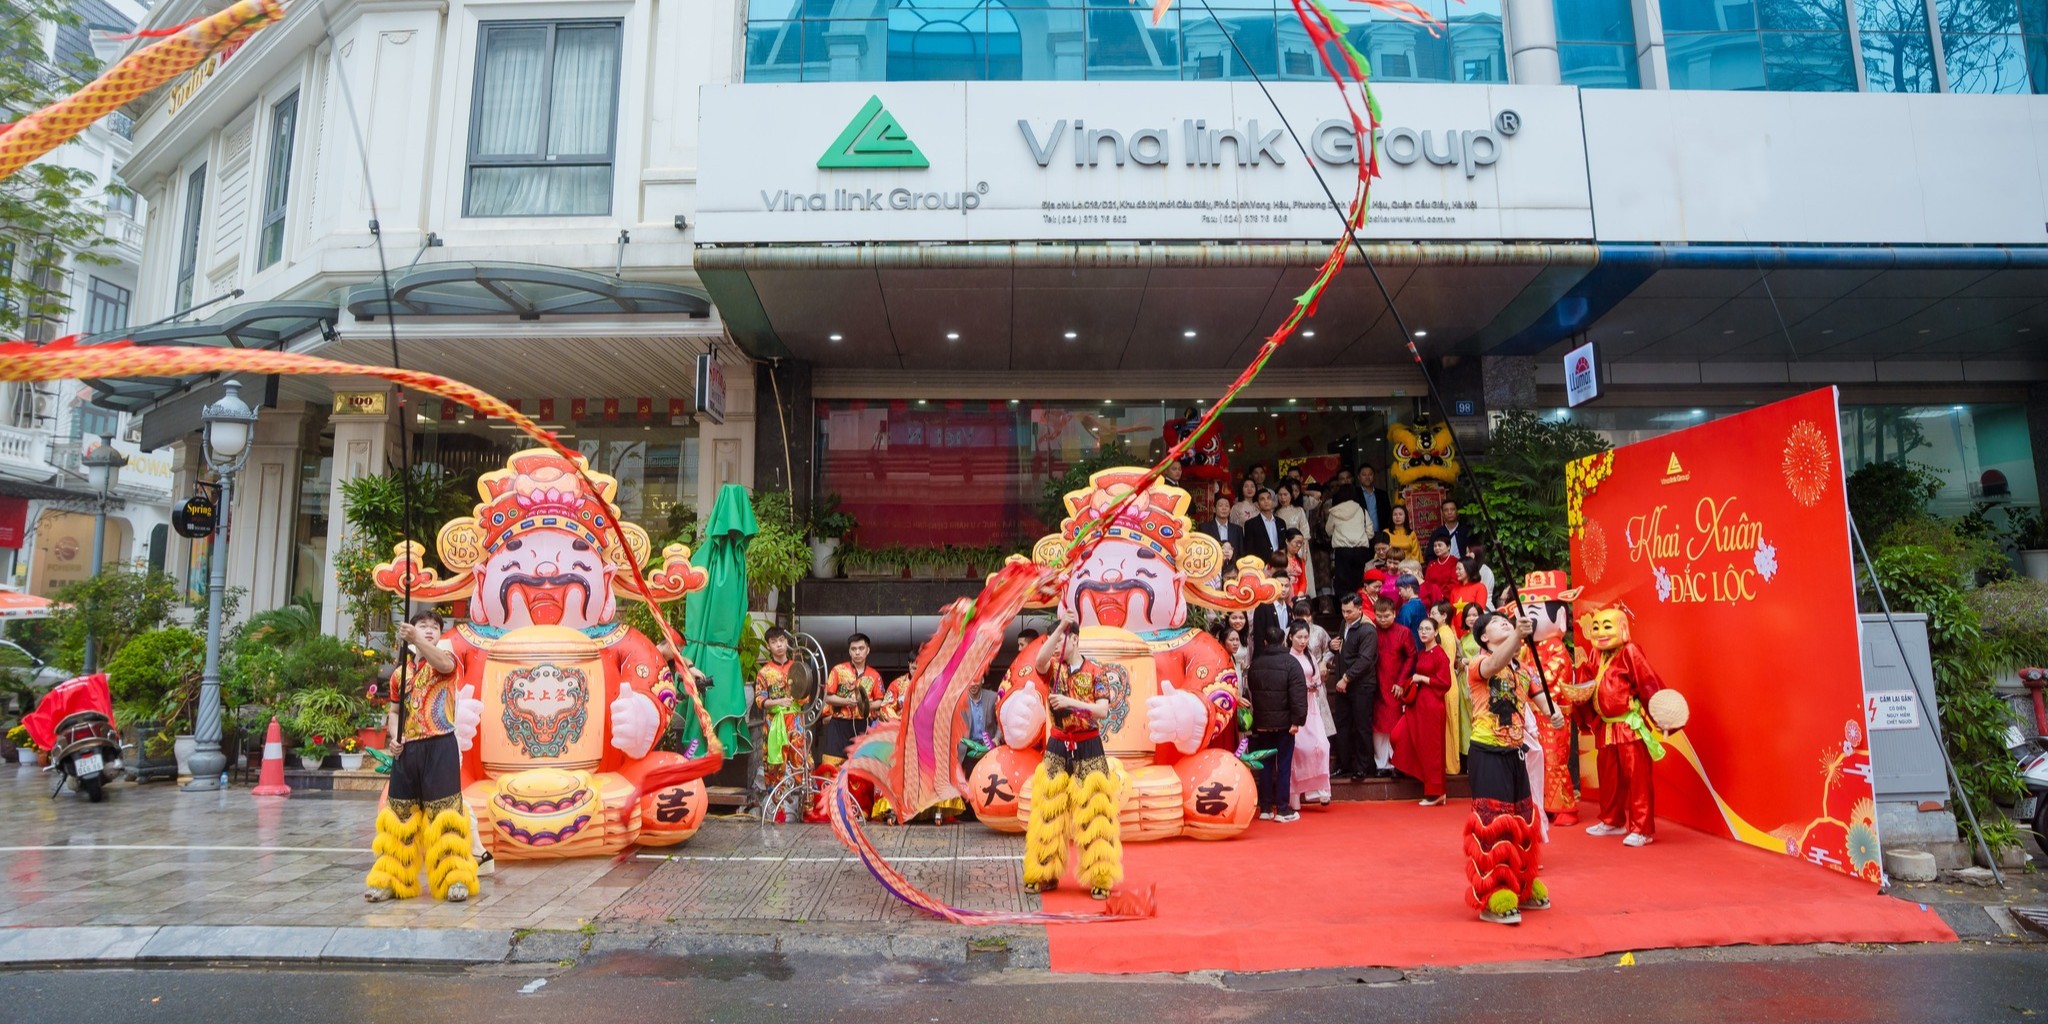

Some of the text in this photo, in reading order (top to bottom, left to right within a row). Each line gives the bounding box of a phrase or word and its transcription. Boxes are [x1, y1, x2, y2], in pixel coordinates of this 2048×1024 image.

[168, 56, 216, 116] Spring
[1017, 119, 1169, 167] Vina
[1183, 119, 1286, 167] link
[760, 189, 826, 211] Vina
[835, 189, 883, 211] link
[349, 397, 373, 405] 100
[1459, 403, 1471, 412] 98
[187, 504, 212, 517] Spring
[1627, 496, 1763, 570] Khai Xuân
[1670, 563, 1757, 606] ĐẮC LỘC
[657, 788, 694, 823] 吉
[982, 774, 1015, 807] 大
[1196, 781, 1234, 816] 吉
